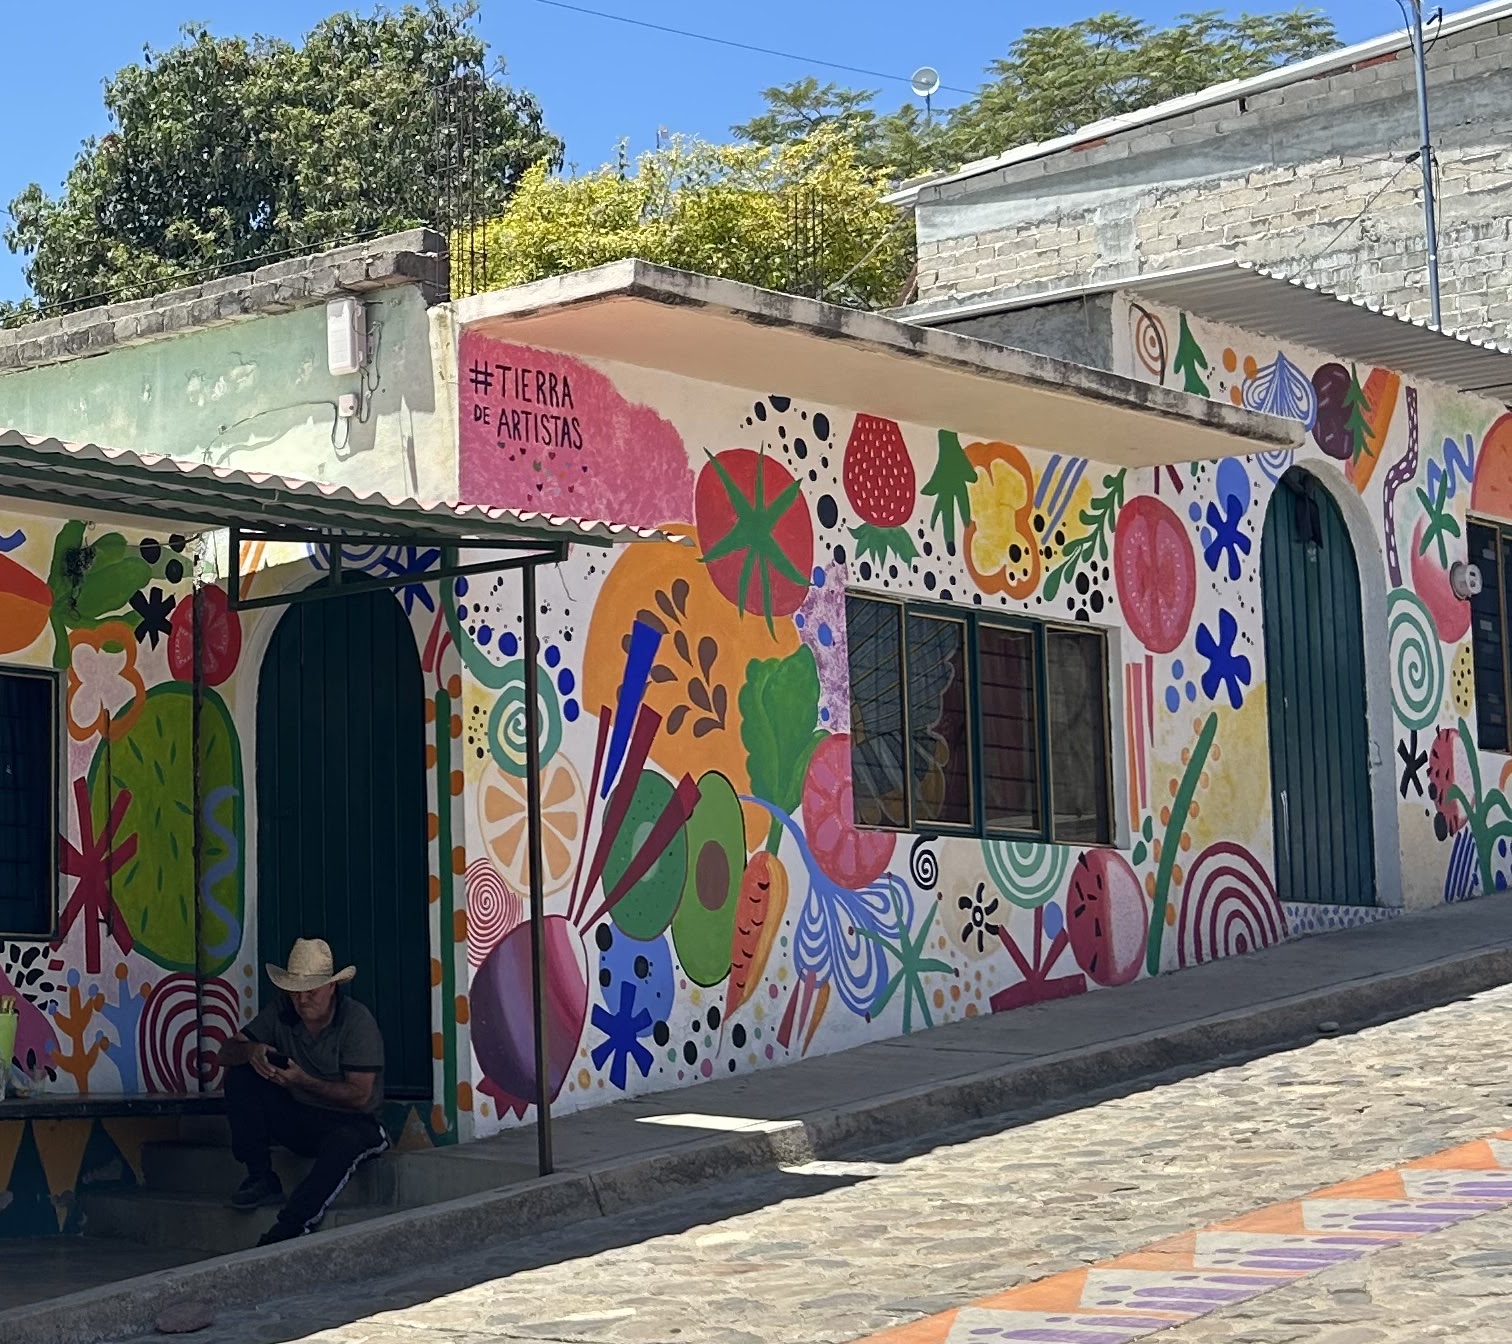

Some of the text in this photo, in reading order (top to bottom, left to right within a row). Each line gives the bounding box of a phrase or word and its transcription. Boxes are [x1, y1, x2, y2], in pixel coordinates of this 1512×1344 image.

[469, 359, 574, 410] #TIERRA
[474, 404, 584, 450] DE ARTISTAS
